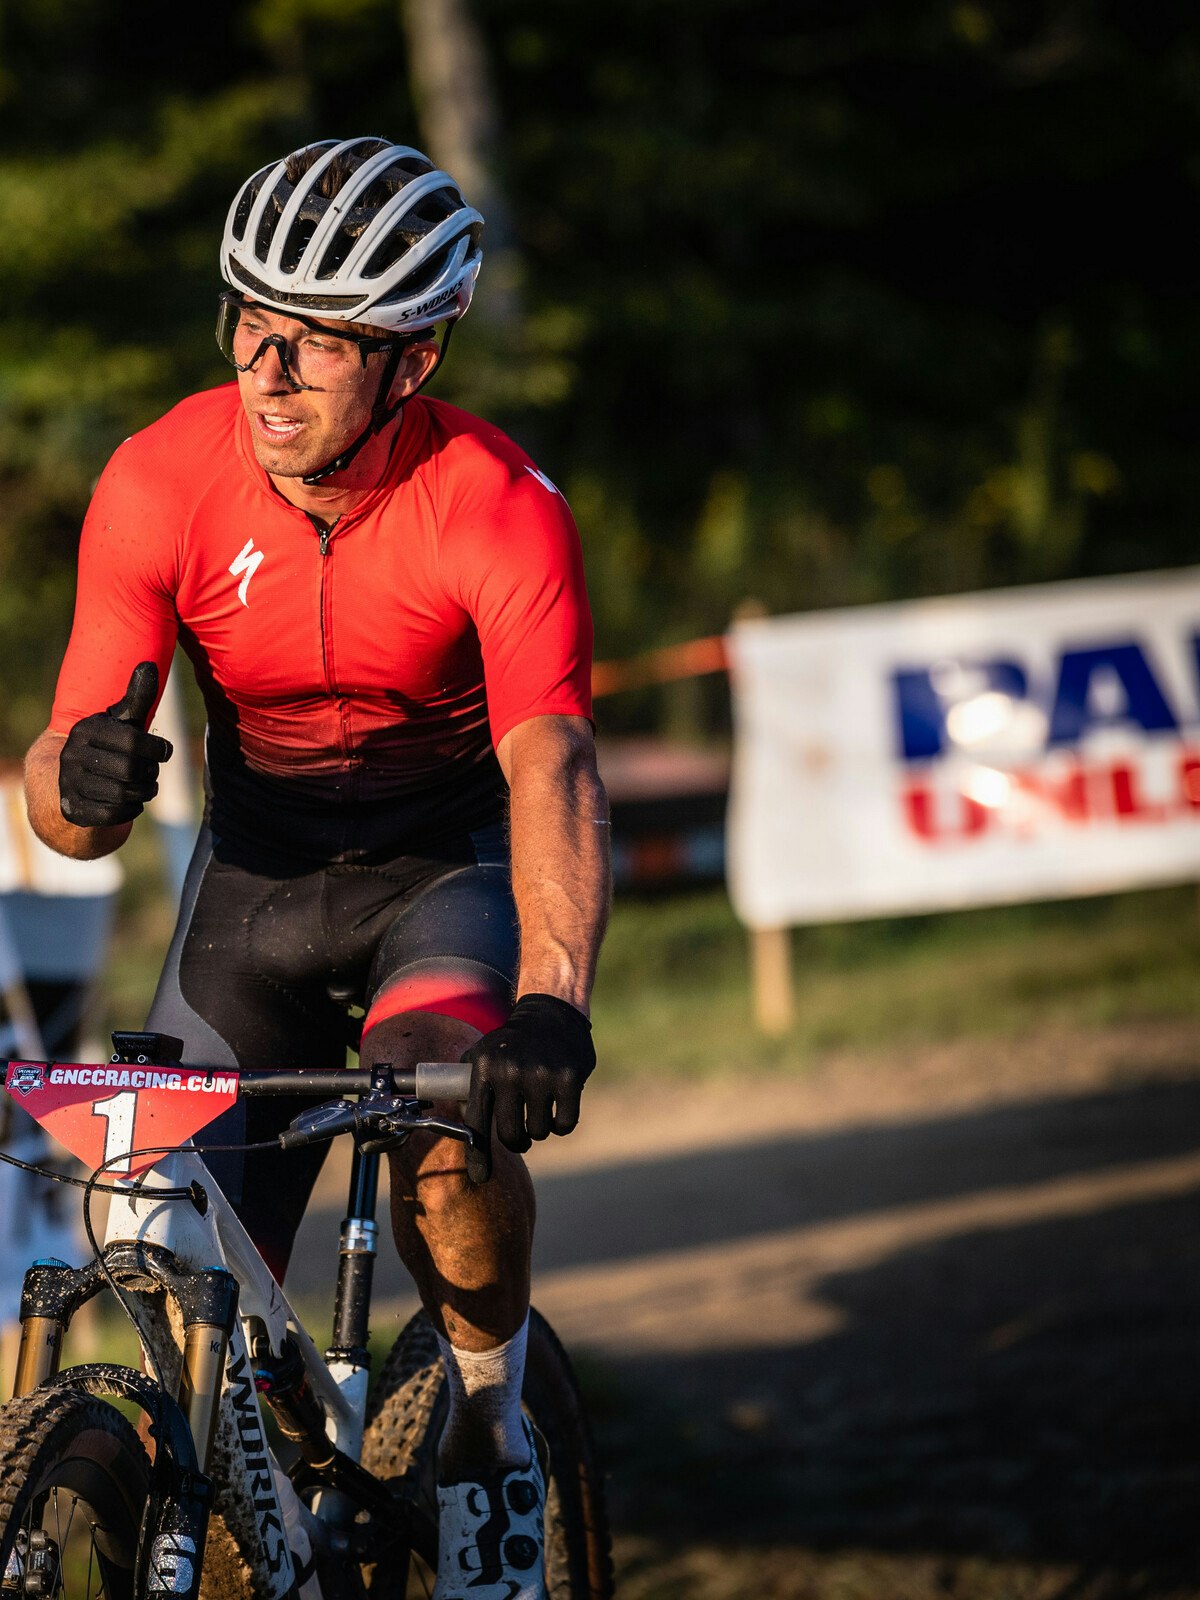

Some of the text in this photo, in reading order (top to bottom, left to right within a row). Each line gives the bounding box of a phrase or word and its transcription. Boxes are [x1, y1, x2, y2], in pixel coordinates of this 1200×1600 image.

[397, 277, 464, 322] S-WORKS
[50, 1068, 237, 1095] GNCCRACING.COM
[91, 1090, 138, 1174] 1
[225, 1314, 291, 1574] -WORKS
